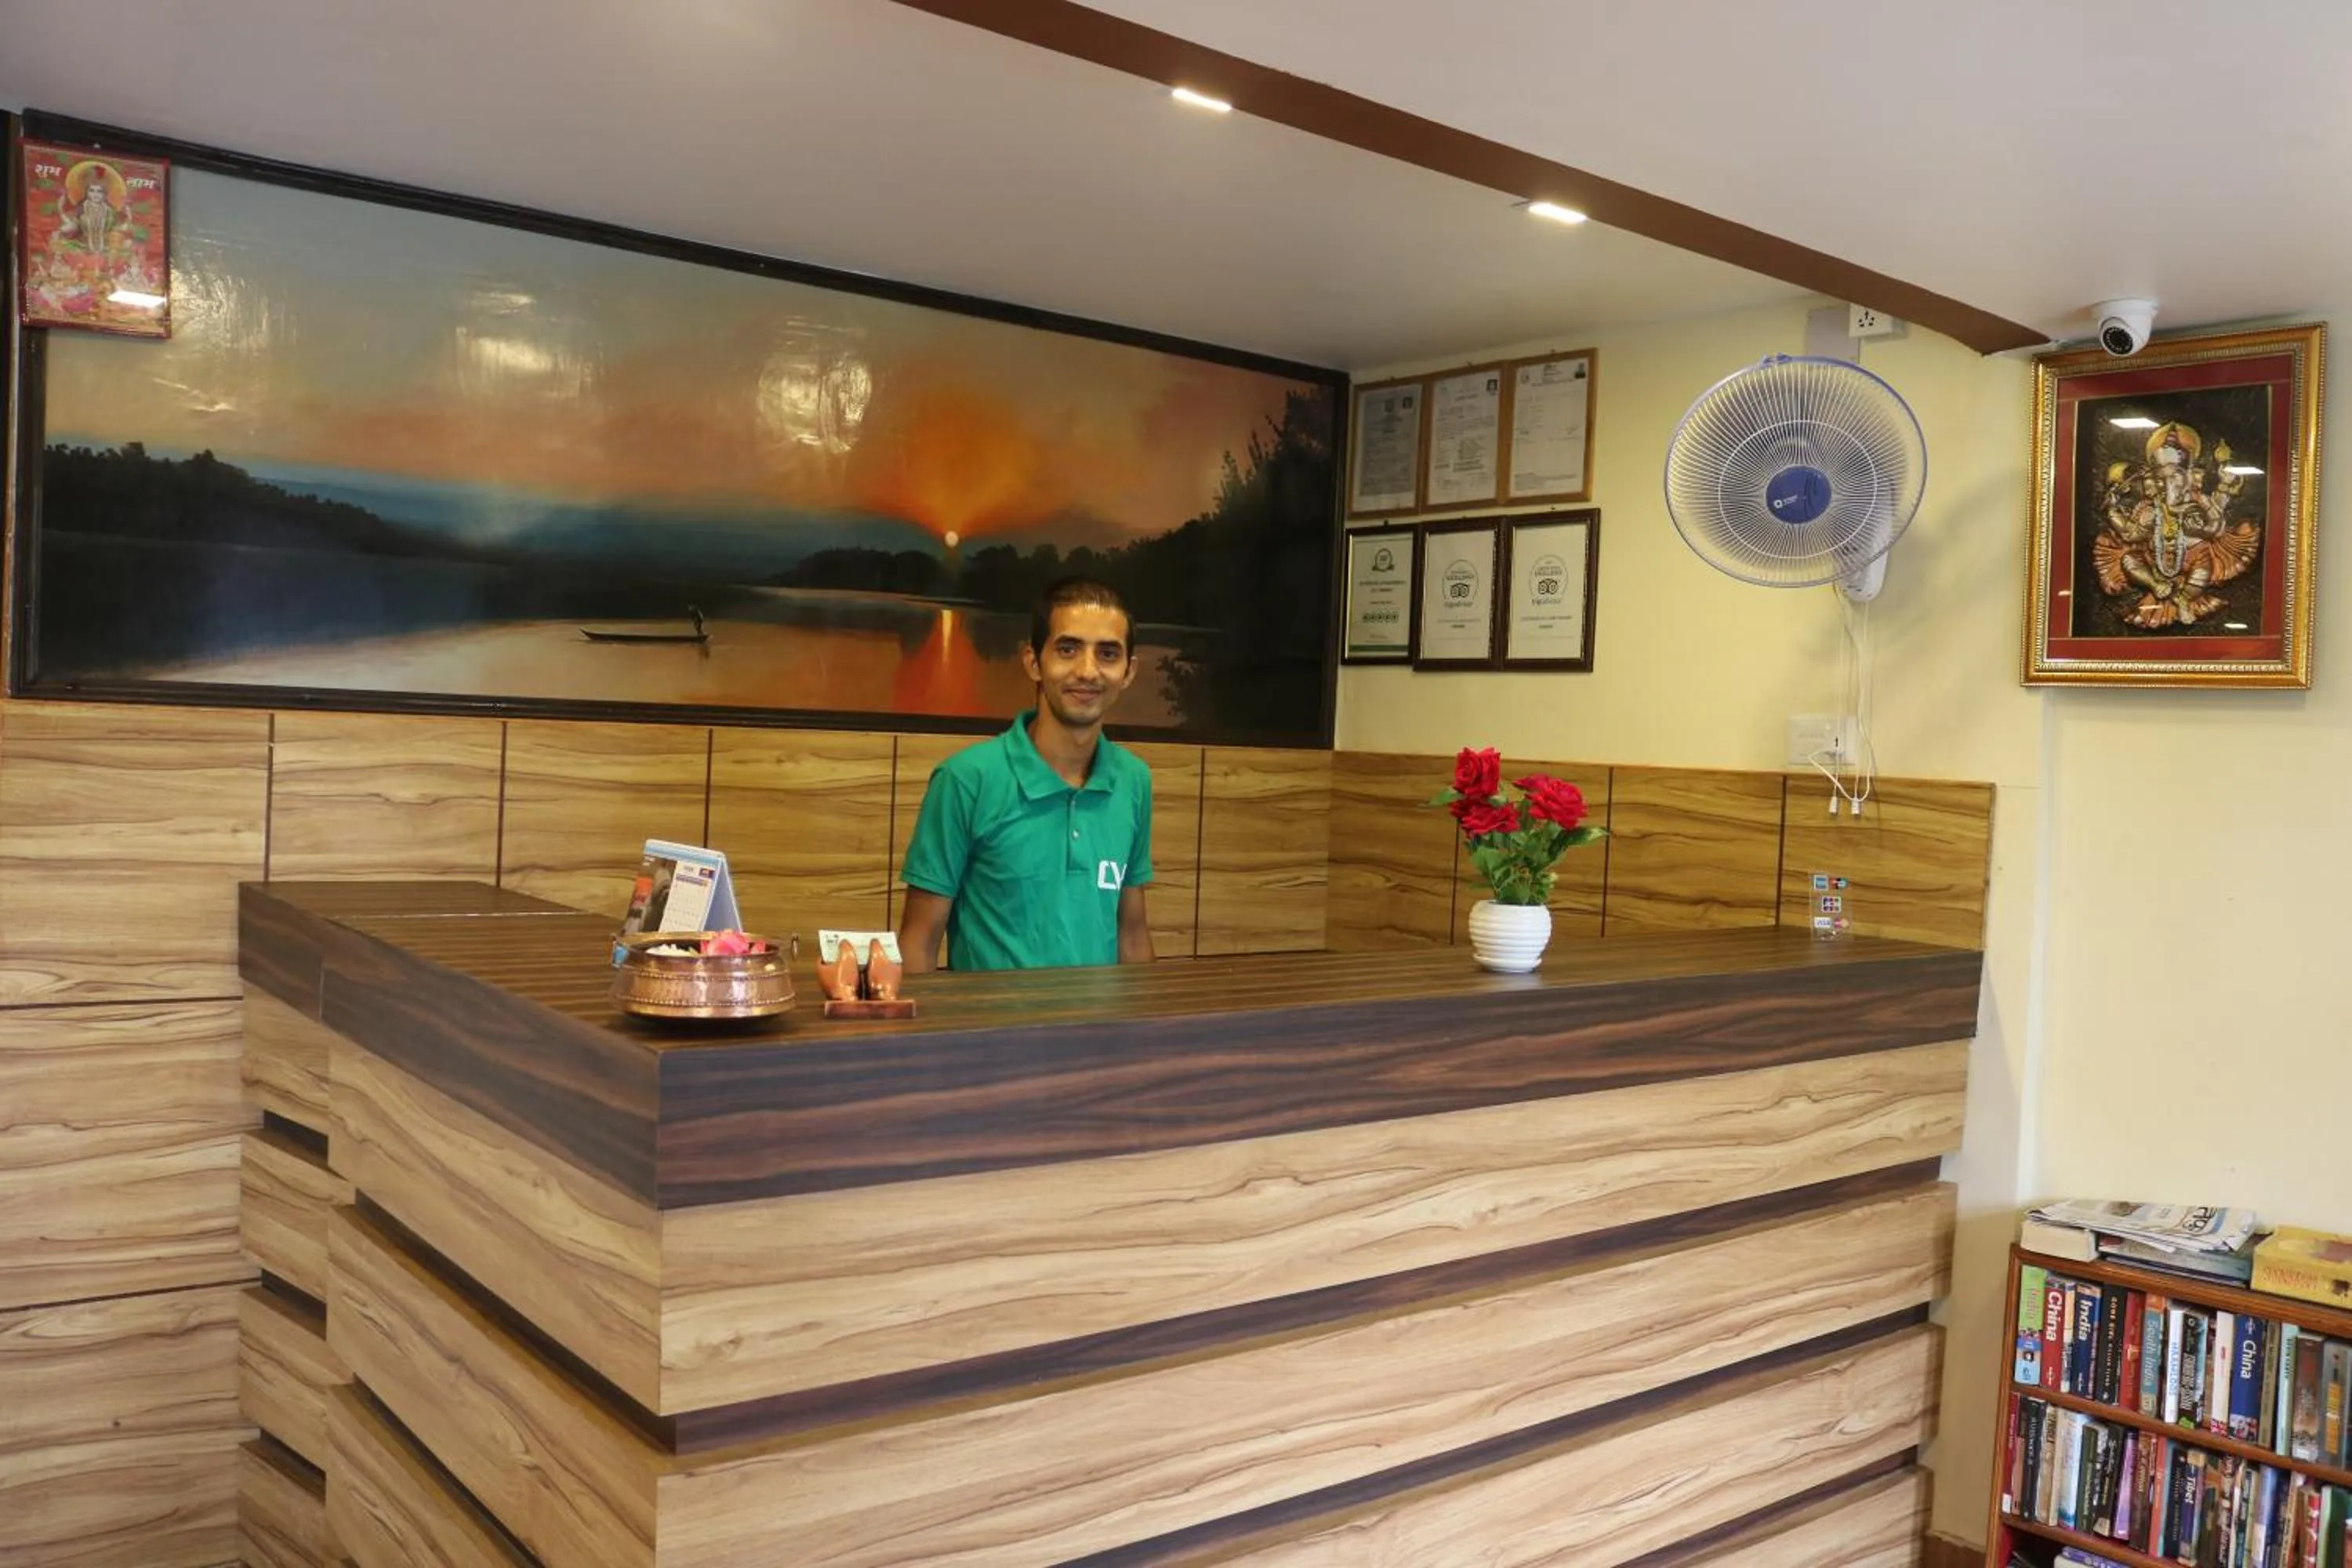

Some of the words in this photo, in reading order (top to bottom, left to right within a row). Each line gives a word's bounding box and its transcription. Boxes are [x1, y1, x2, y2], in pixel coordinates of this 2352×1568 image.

[2045, 1291, 2063, 1342] China
[2078, 1299, 2093, 1341] India
[2146, 1319, 2158, 1354] South
[2240, 1339, 2258, 1380] China
[2185, 1476, 2196, 1504] Tibet
